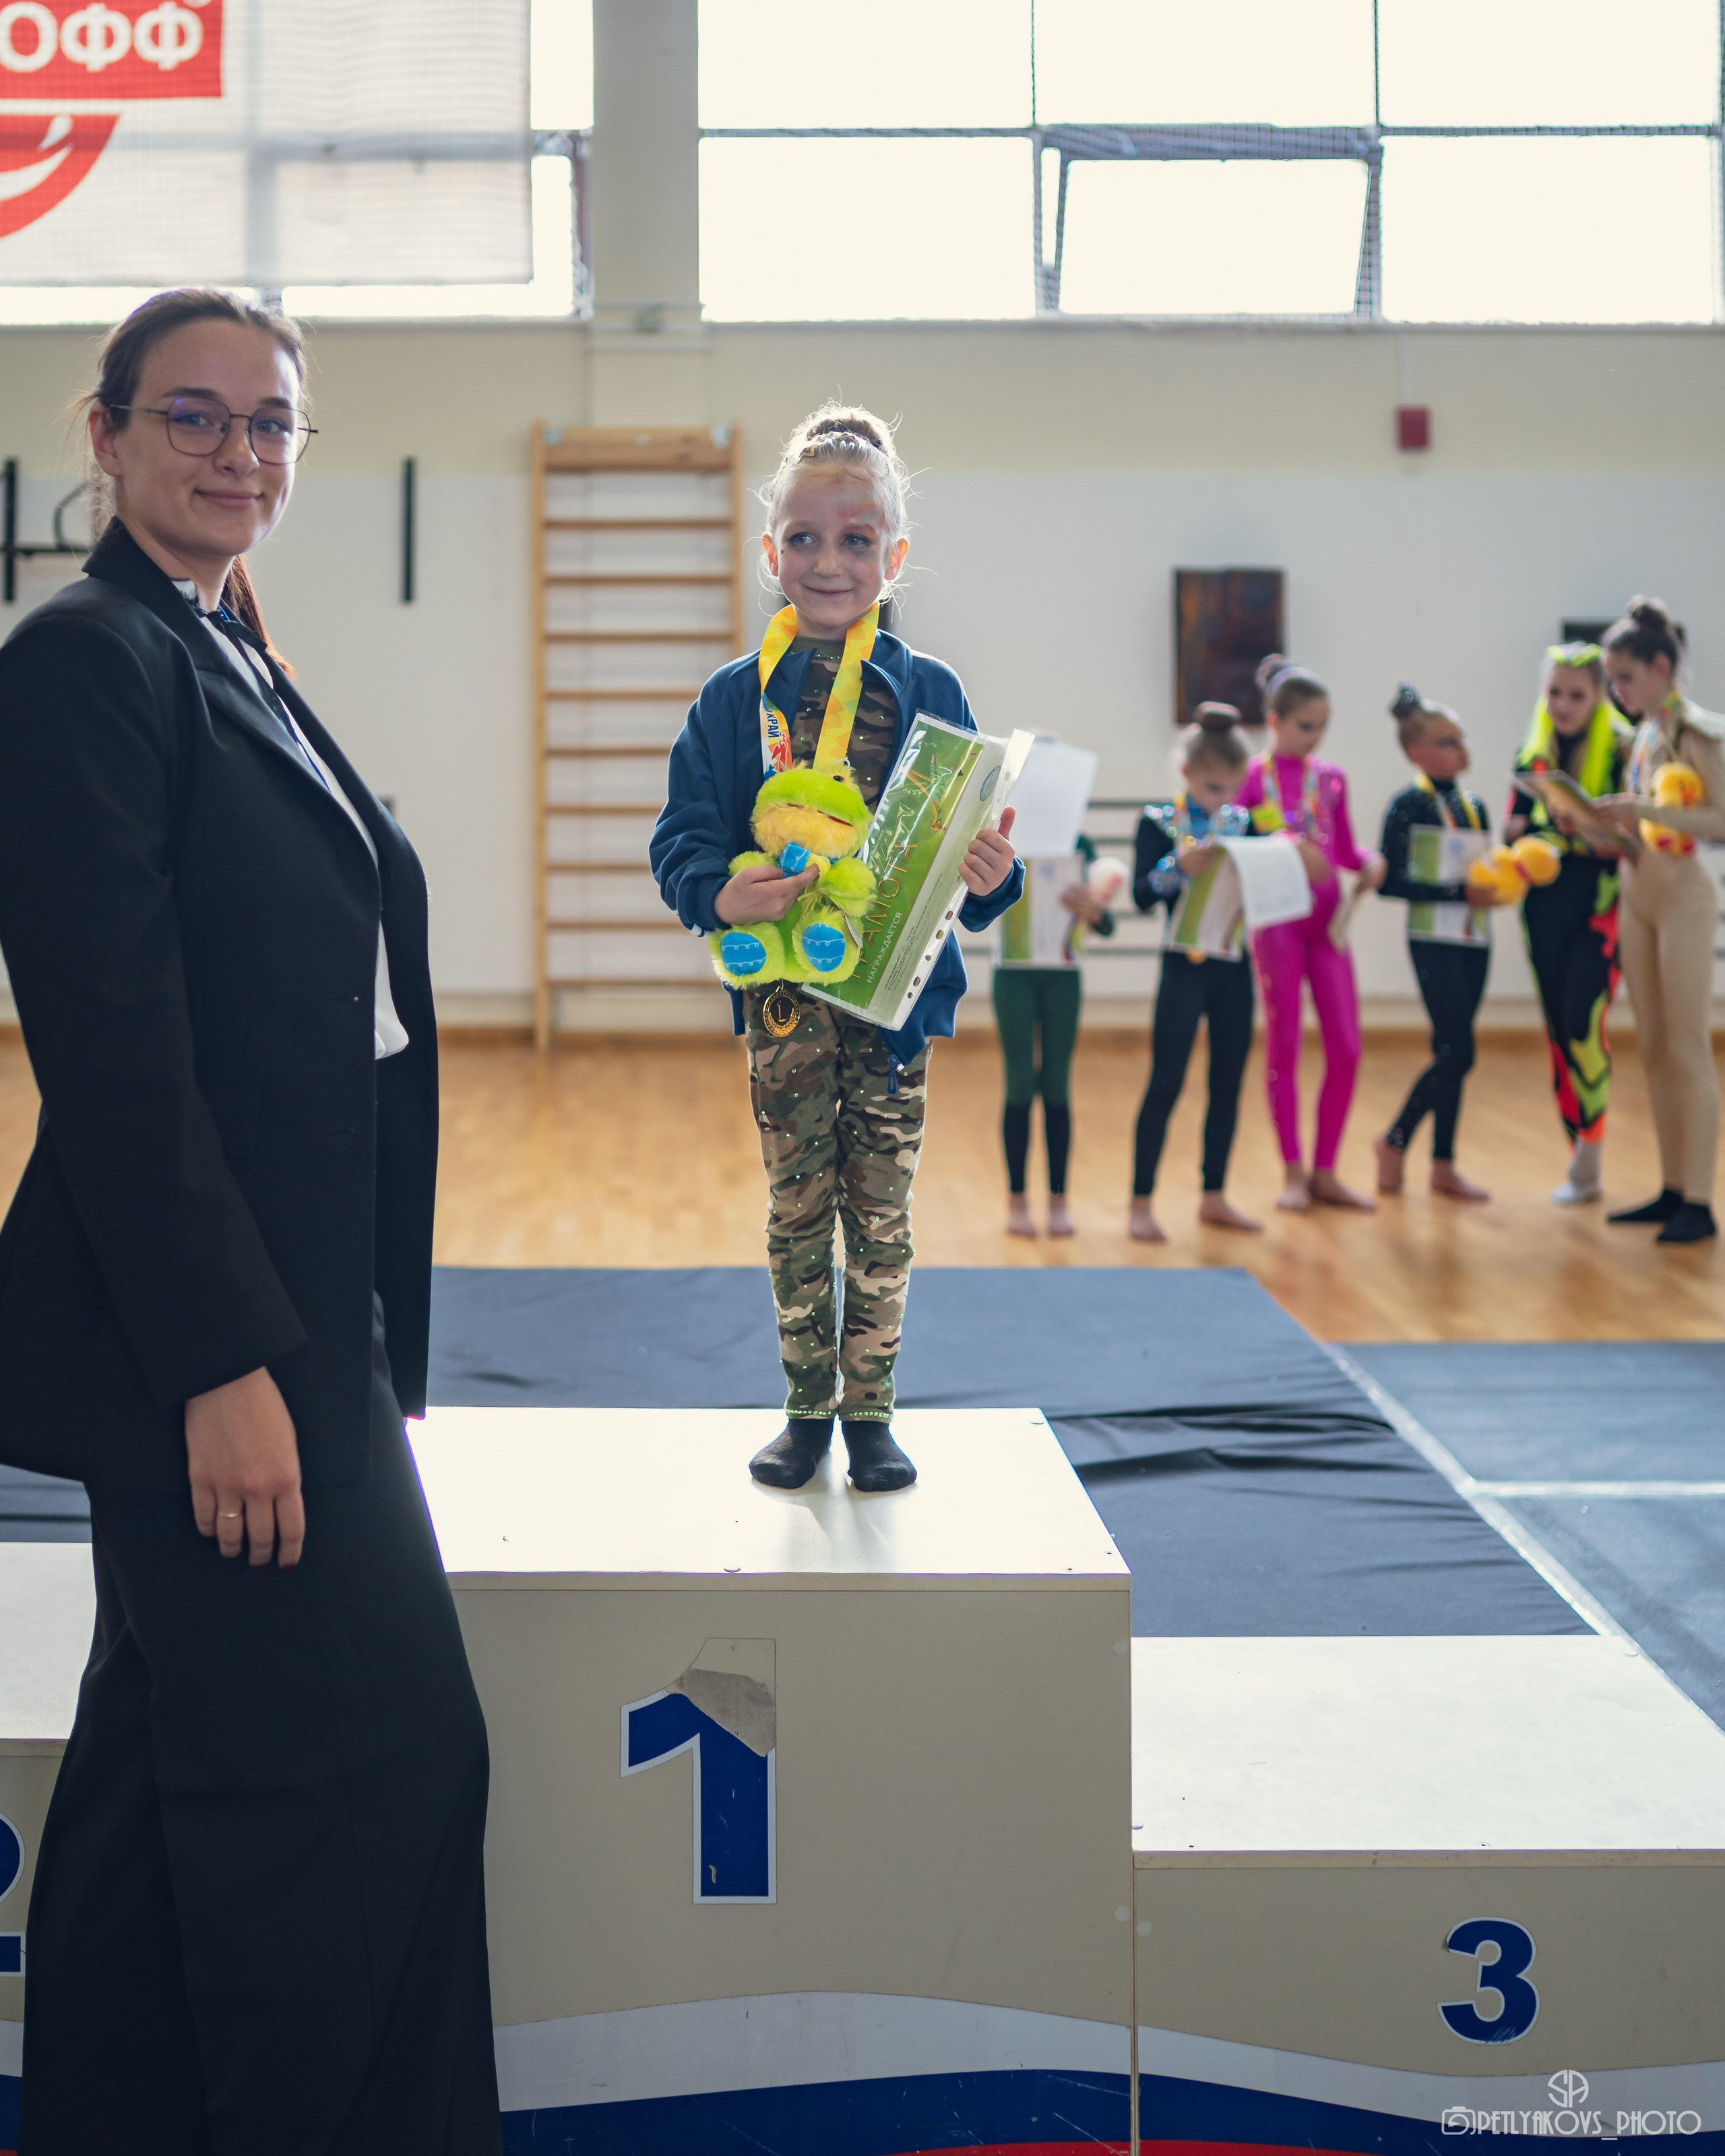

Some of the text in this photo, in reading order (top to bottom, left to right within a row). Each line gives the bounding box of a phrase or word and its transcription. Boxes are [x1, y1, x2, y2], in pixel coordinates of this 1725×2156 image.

[766, 713, 782, 738] КРАЙ
[866, 911, 903, 984] НАГРАЖДАЕТСЯ
[620, 1637, 777, 1904] 1
[1437, 1916, 1541, 2046] 3
